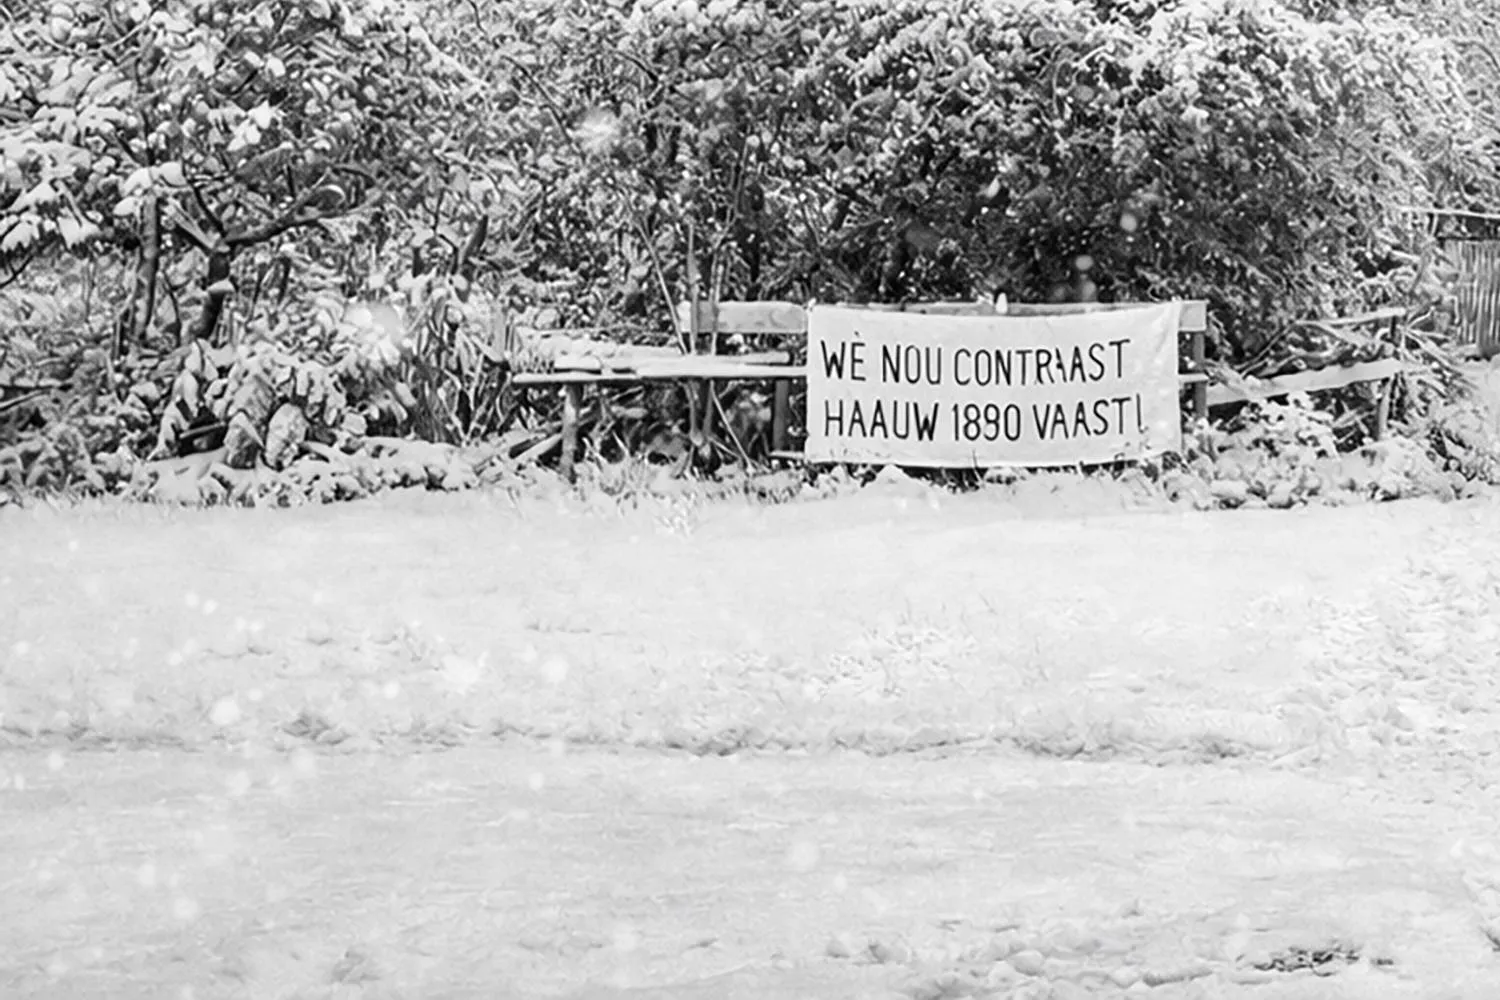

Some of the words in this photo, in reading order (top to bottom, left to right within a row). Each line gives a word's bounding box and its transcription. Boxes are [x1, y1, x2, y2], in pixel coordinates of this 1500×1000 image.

[882, 344, 942, 385] NOU
[824, 398, 940, 442] HAAUW
[952, 402, 1022, 442] 1890
[1032, 393, 1145, 441] VAAST!
